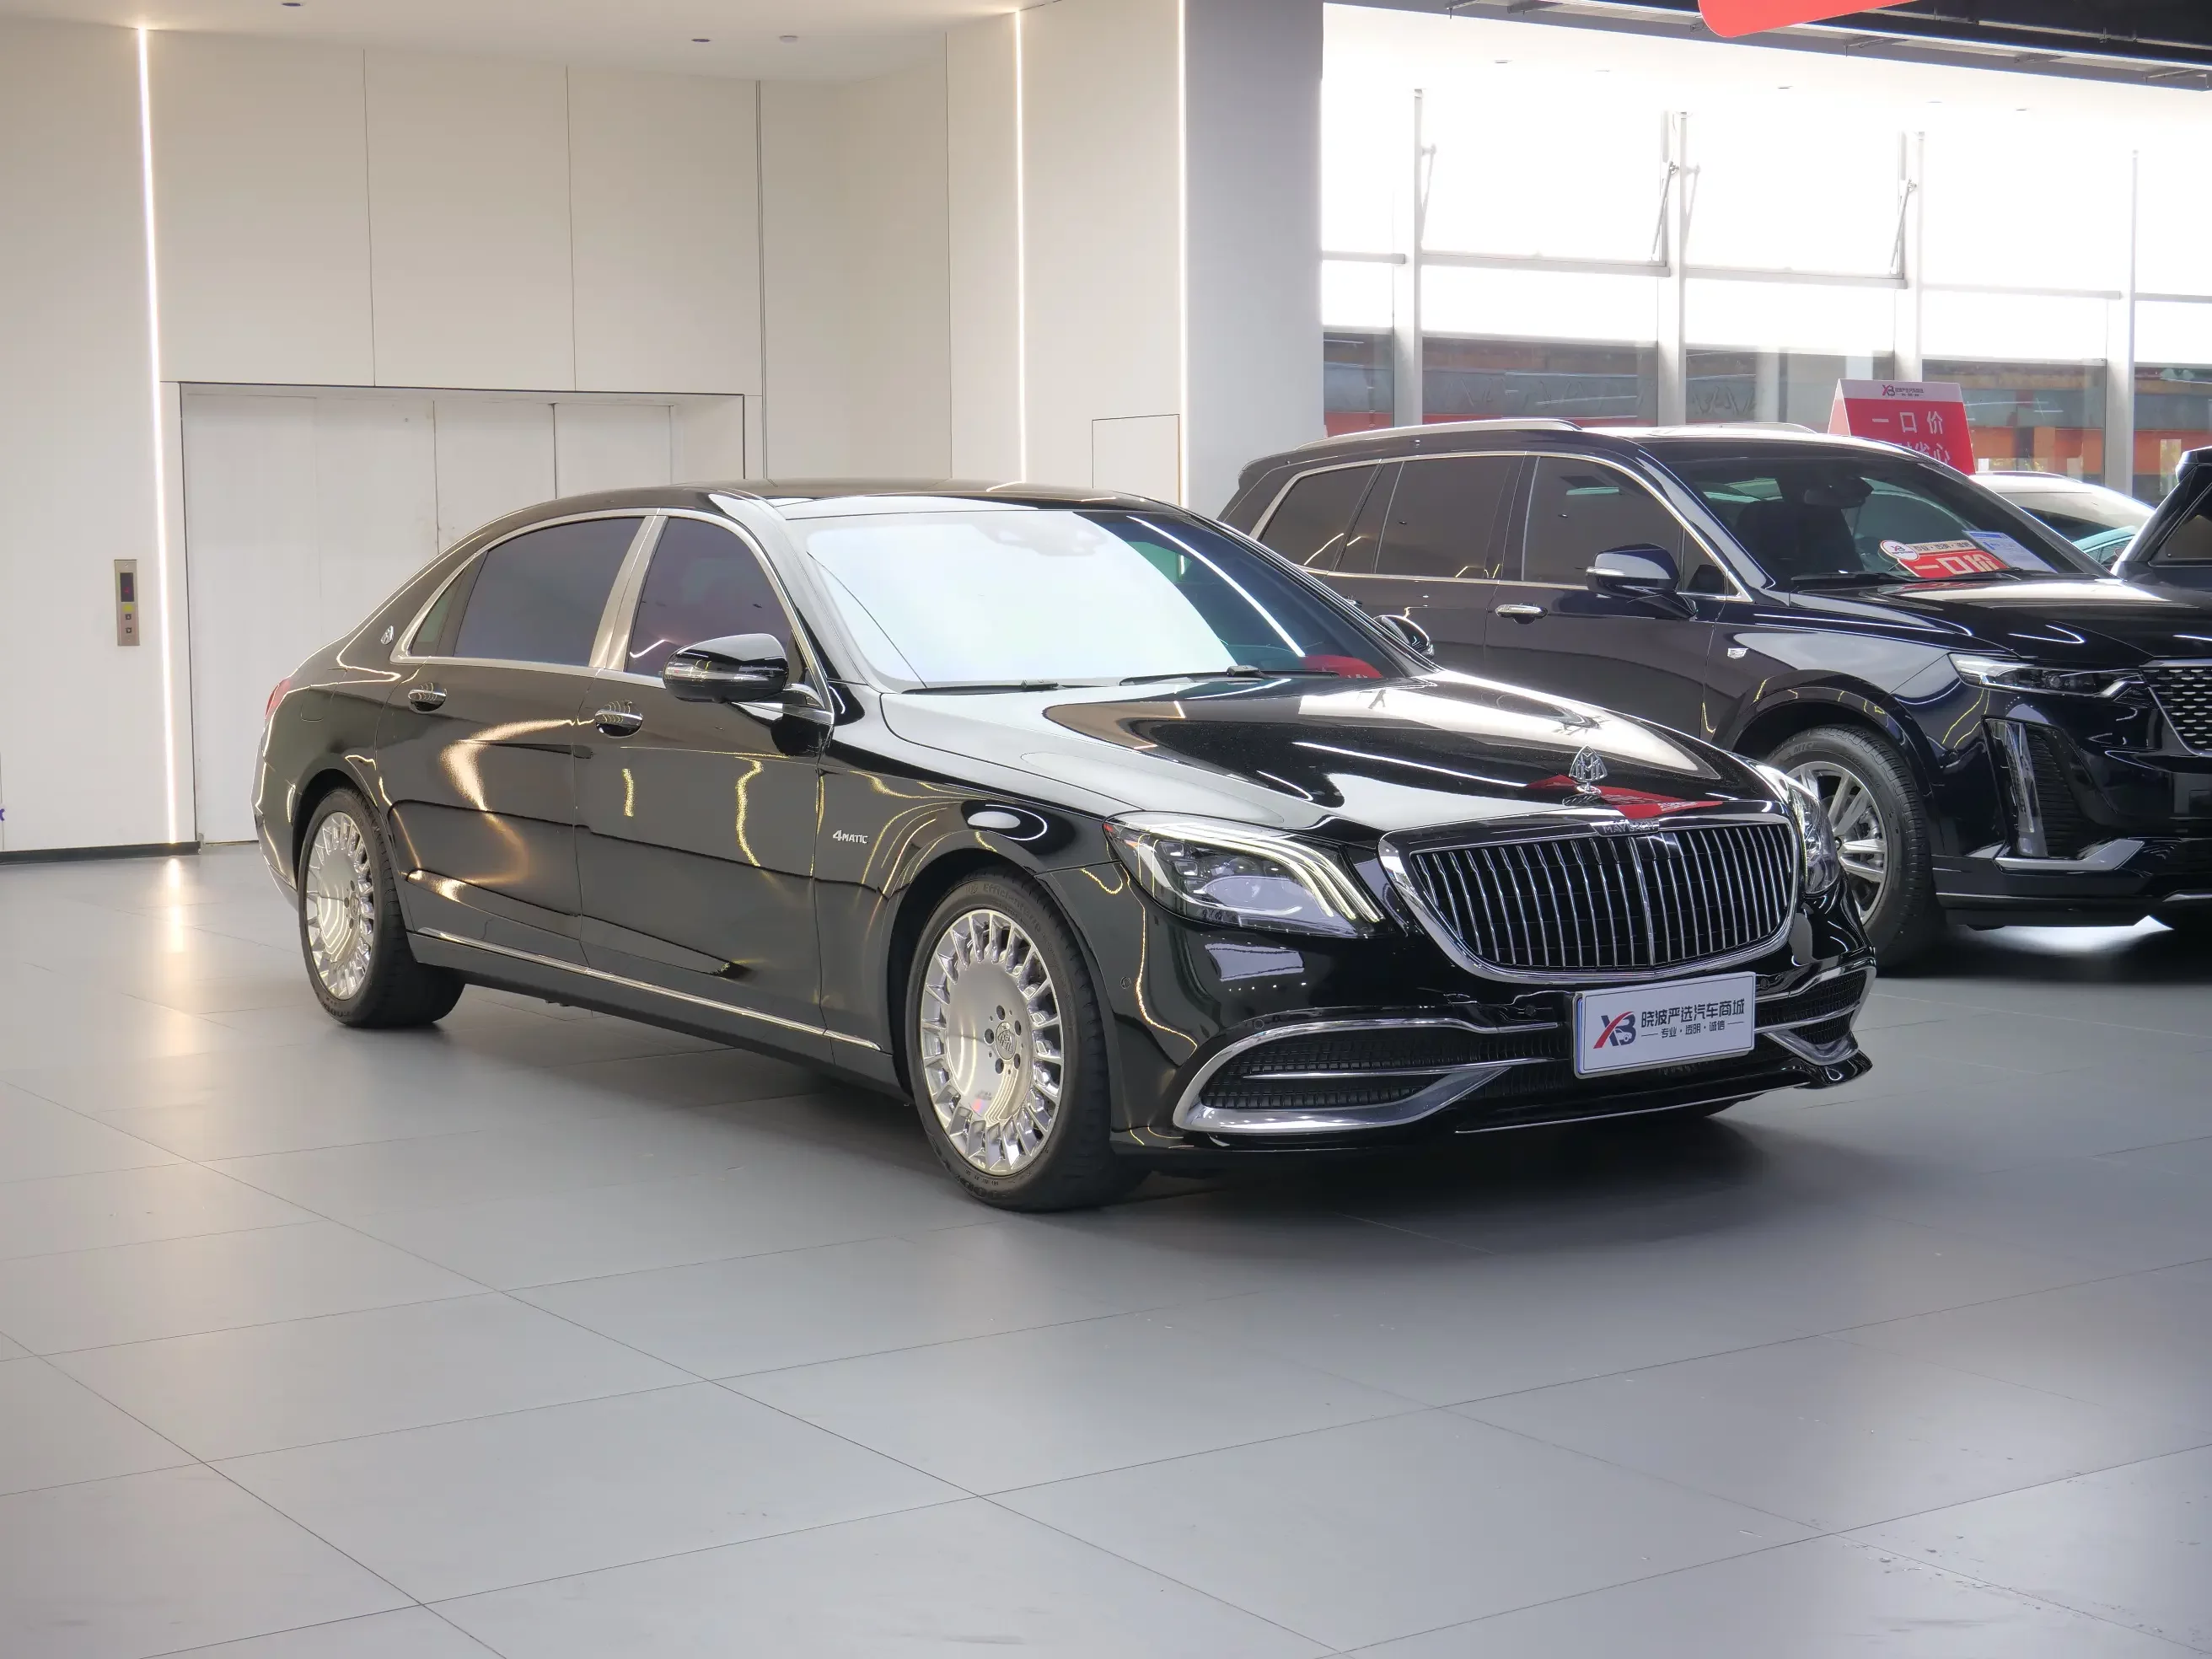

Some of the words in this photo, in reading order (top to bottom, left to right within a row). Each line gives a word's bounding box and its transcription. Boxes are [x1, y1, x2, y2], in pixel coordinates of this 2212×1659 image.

[1871, 411, 1943, 435] 一口价
[1914, 553, 2000, 575] 一口价
[1640, 998, 1745, 1028] 晓波严选汽车商城
